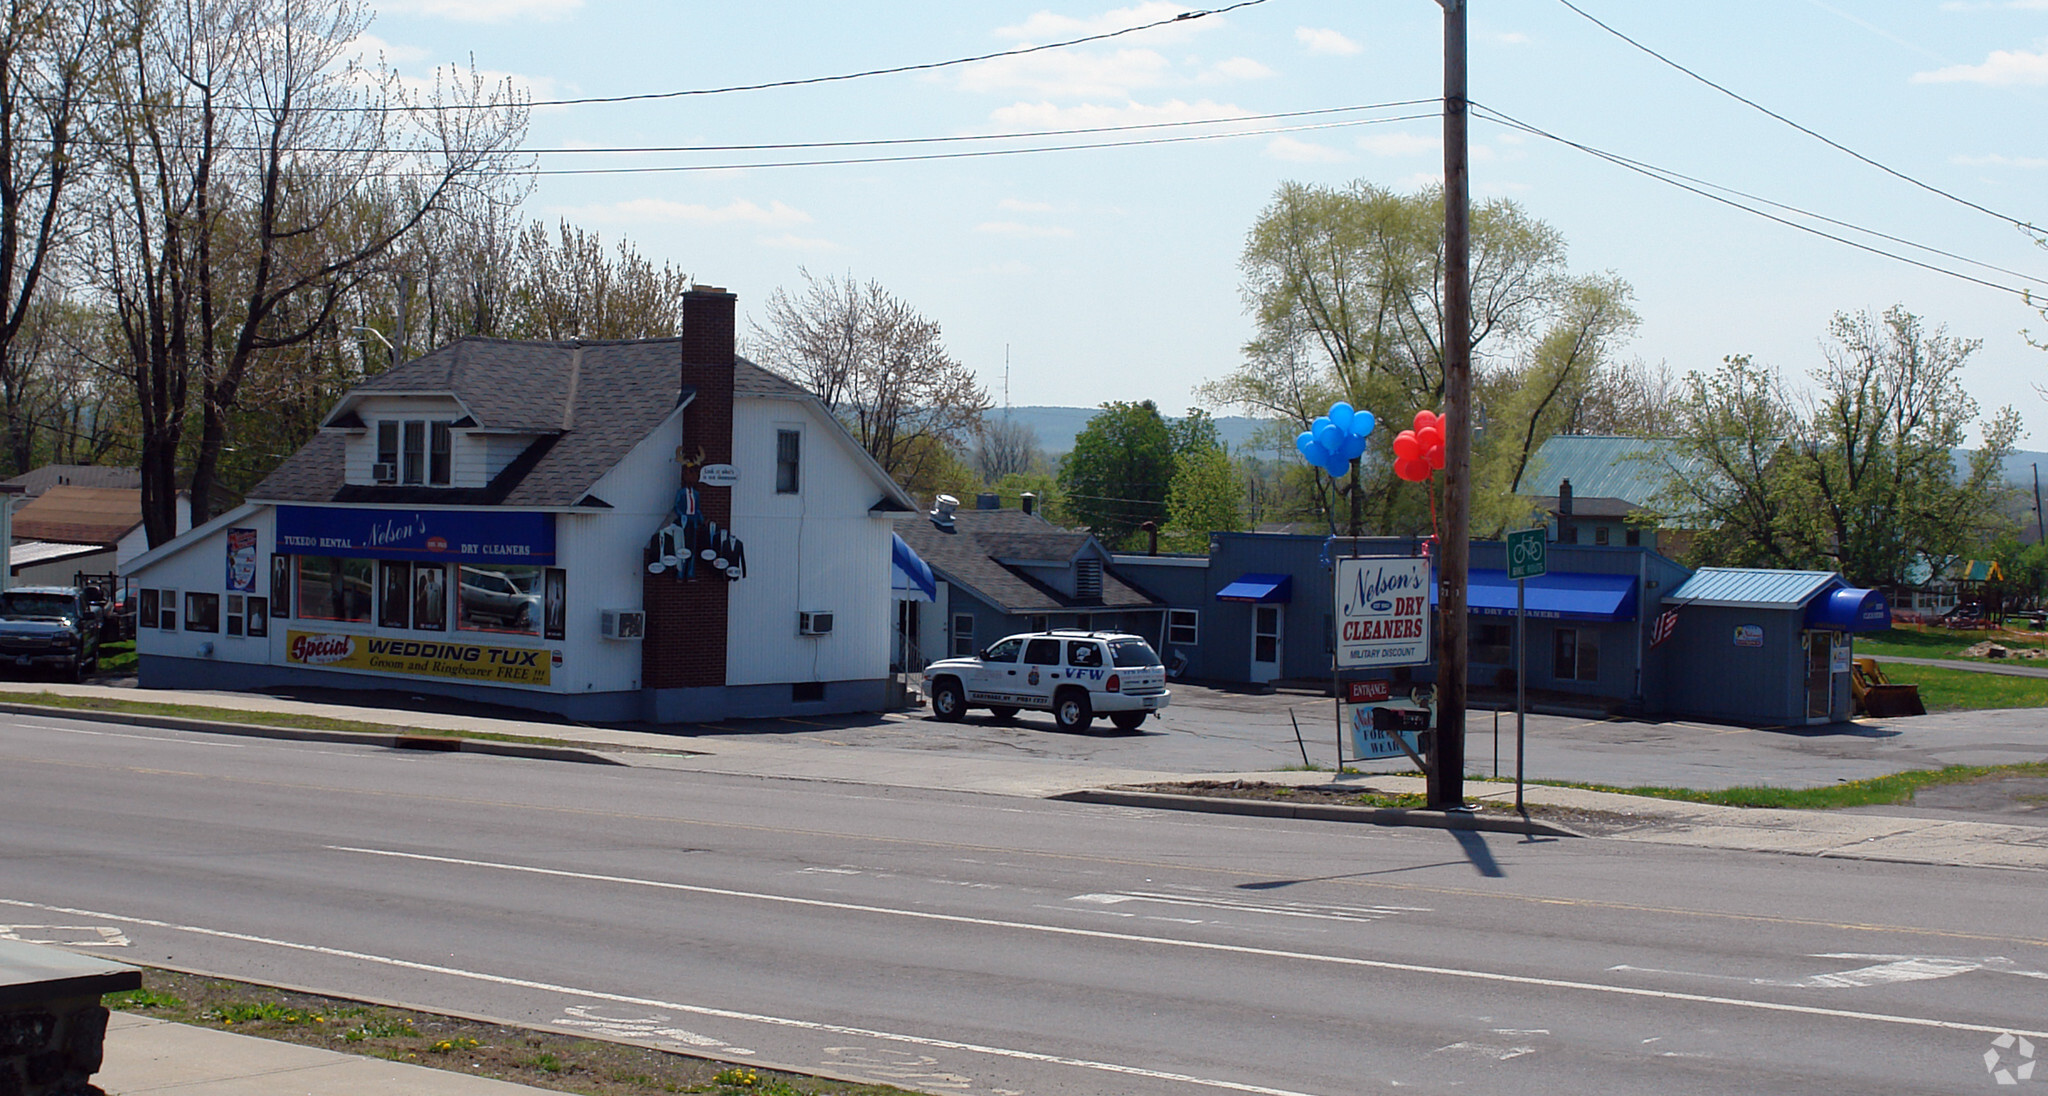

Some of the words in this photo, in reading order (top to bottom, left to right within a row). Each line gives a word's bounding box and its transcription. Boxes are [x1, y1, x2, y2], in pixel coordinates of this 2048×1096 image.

[363, 513, 426, 548] Nelson's
[284, 535, 317, 546] TUXEDO
[320, 538, 352, 548] RENTAL
[461, 543, 479, 554] DRY
[482, 544, 530, 555] CLEANERS
[1513, 565, 1525, 576] BIKE
[1527, 562, 1544, 574] ROUTE
[1344, 566, 1423, 616] Nelson's
[1394, 597, 1425, 616] DRY
[1484, 608, 1504, 616] DRY
[1508, 609, 1560, 619] CLANERS
[1343, 618, 1424, 642] CLEANERS
[291, 634, 351, 664] Special
[368, 639, 481, 662] WEDDING
[488, 649, 540, 667] TUX
[1350, 649, 1380, 659] MILITARY
[1381, 647, 1415, 658] DISCOUNT
[369, 655, 404, 667] Groom
[407, 660, 428, 671] and
[432, 661, 492, 677] Ringbearer
[497, 667, 530, 680] FREE
[1066, 668, 1105, 680] VFW
[1353, 684, 1387, 698] ENTRANCE
